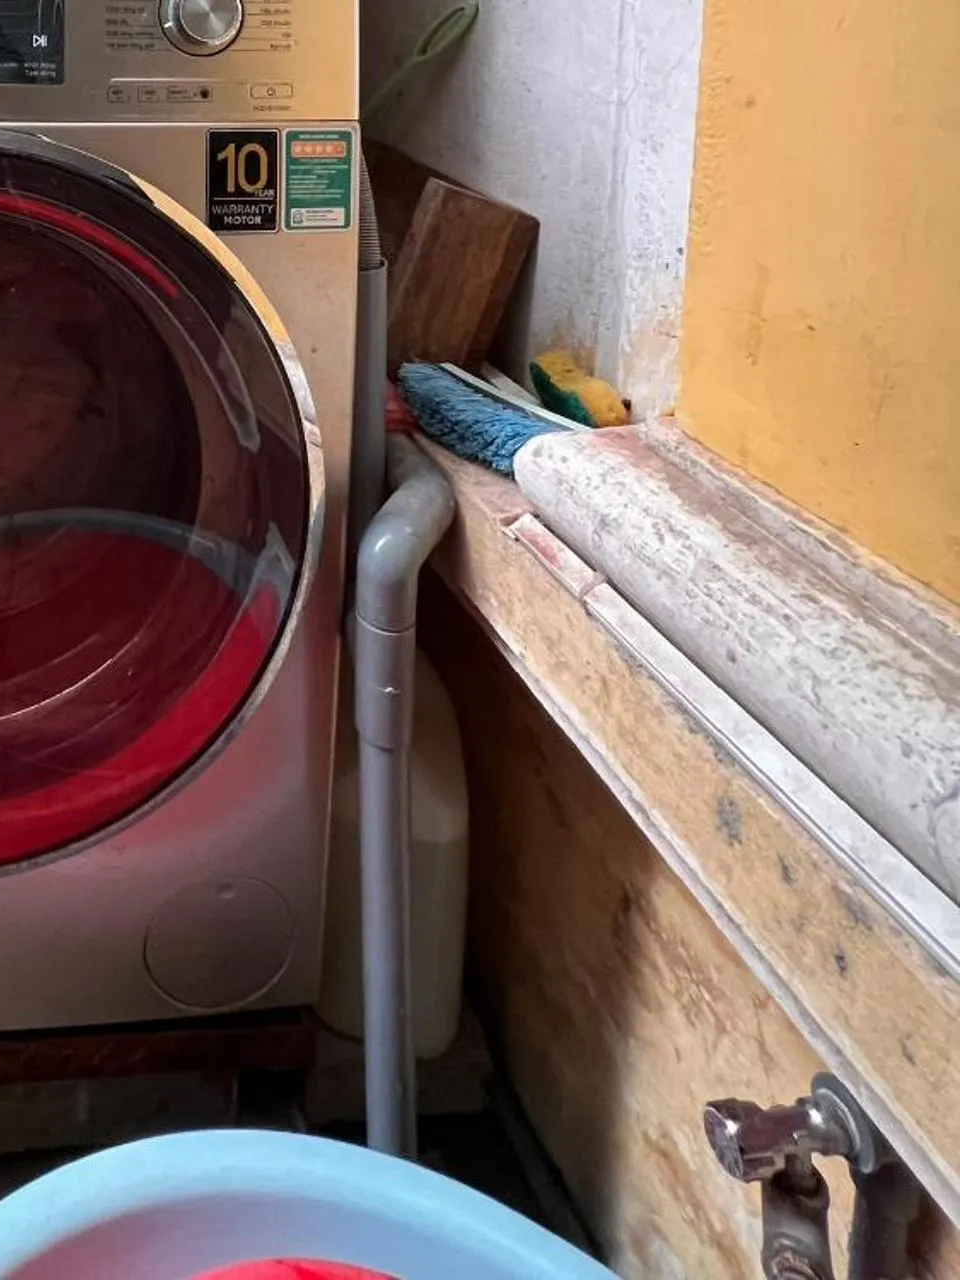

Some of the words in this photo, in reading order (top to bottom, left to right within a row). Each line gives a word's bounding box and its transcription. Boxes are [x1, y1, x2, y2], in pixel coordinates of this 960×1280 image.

[216, 142, 268, 194] 10
[212, 204, 274, 214] WARRANTY
[223, 216, 262, 225] MOTOR
